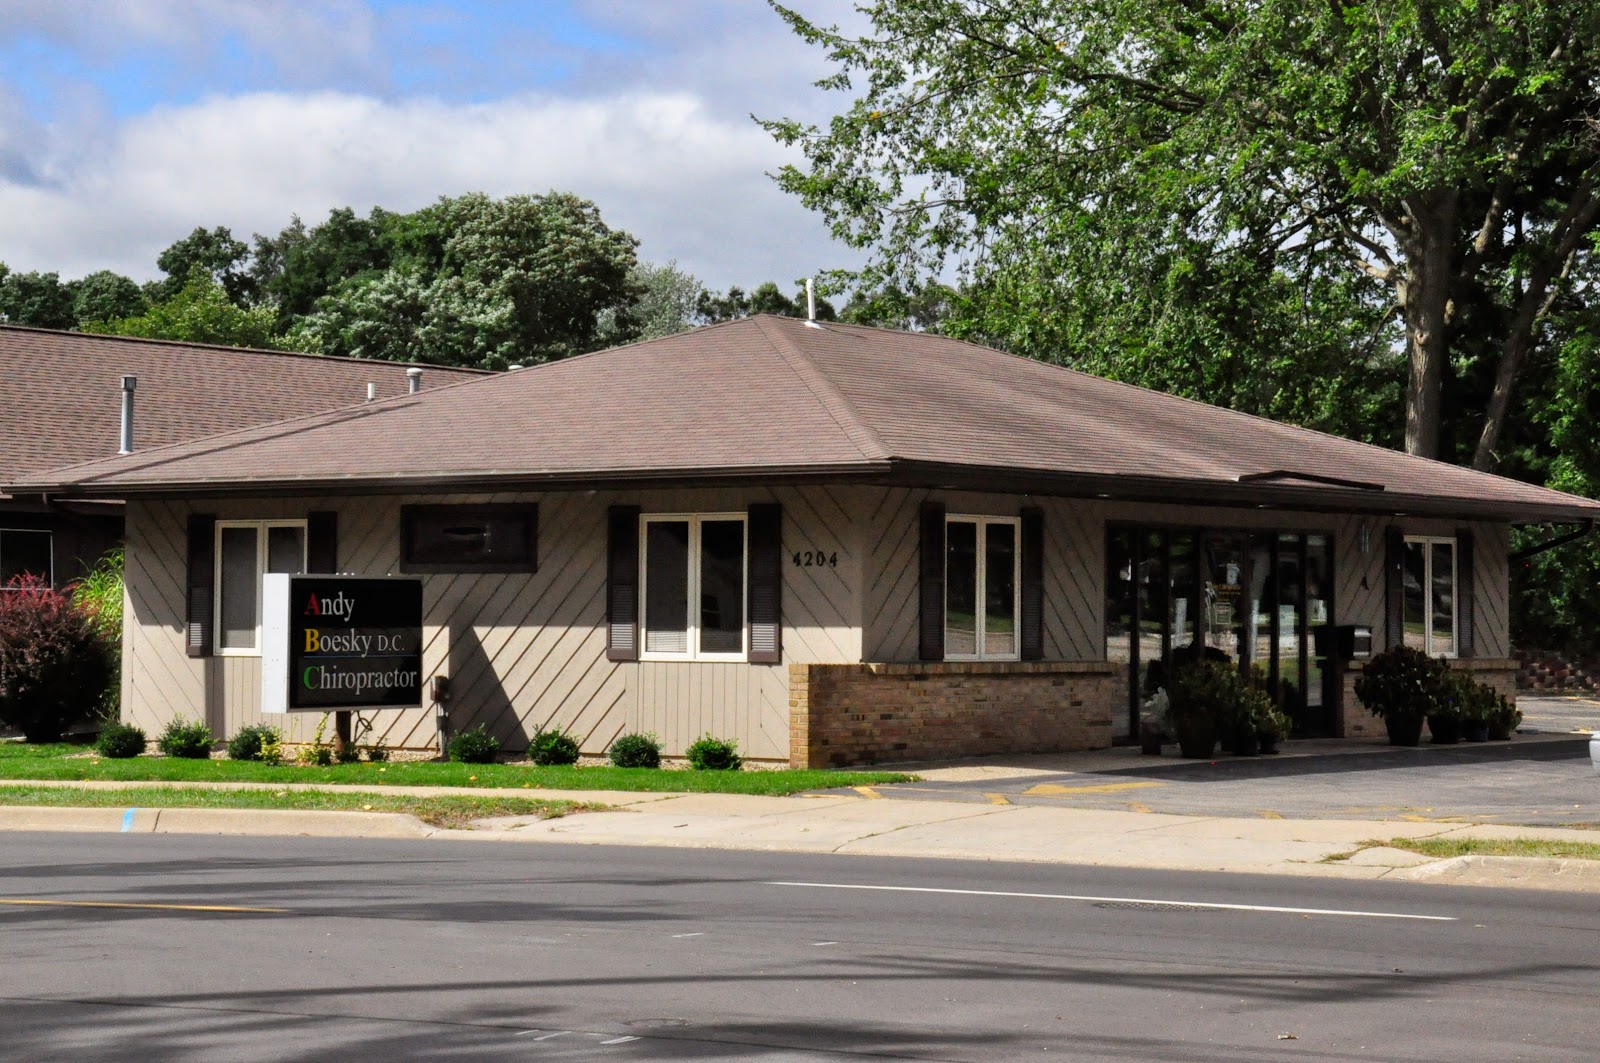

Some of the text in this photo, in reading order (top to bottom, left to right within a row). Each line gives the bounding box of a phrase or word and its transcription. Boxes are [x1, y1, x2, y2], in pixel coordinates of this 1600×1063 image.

[792, 551, 838, 567] 4204
[304, 591, 355, 622] Andy
[304, 628, 405, 658] Boesky D.C.
[303, 665, 417, 695] Chiropractor
